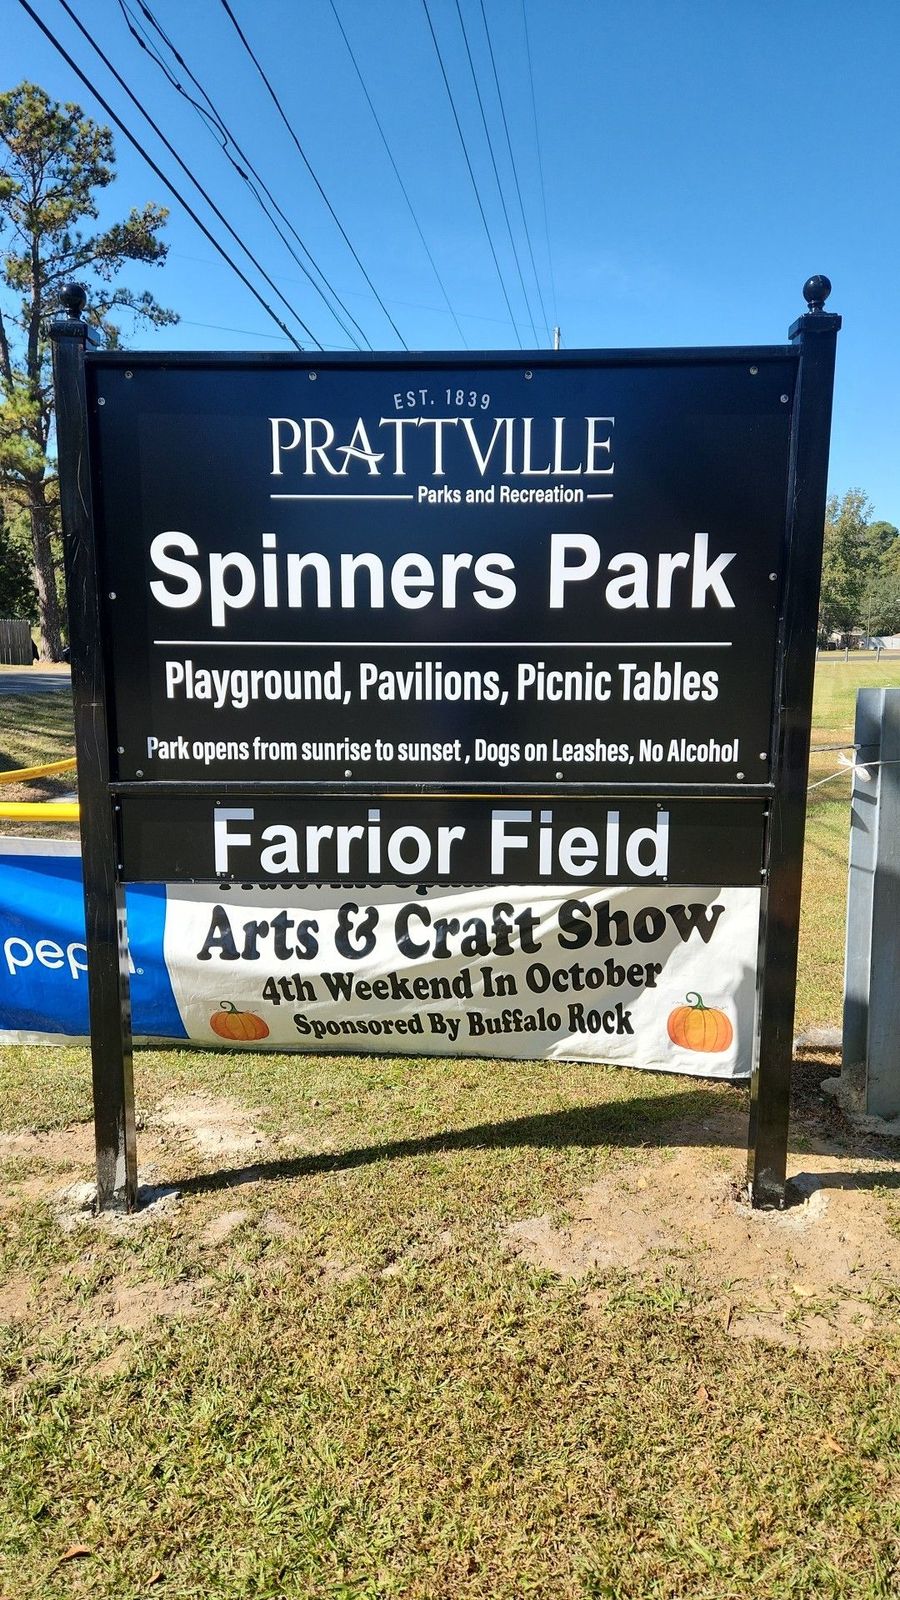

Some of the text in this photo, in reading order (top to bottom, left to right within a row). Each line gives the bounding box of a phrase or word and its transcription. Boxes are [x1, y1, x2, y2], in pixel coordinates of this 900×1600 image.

[394, 389, 489, 409] EST. 1839
[268, 417, 614, 476] PRATTVILLE
[418, 485, 583, 503] Parks and Recreation
[150, 532, 736, 626] Spinners Park
[166, 660, 718, 708] Playground, Pavilions, Picnic Tables
[148, 736, 190, 759] Park
[193, 742, 249, 765] opens
[253, 737, 297, 760] from
[302, 738, 371, 761] sunrise
[375, 739, 393, 761] to
[475, 739, 520, 767] Dogs
[525, 744, 547, 761] on
[553, 739, 634, 764] Leashes,
[639, 739, 663, 762] No
[667, 739, 738, 762] Alcohol
[214, 808, 669, 877] Farrior Field
[197, 898, 725, 960] Arts & Craft Show
[262, 957, 663, 1006] 4th Weekend In October
[293, 1001, 635, 1041] Sponsored By Buffalo Rock
